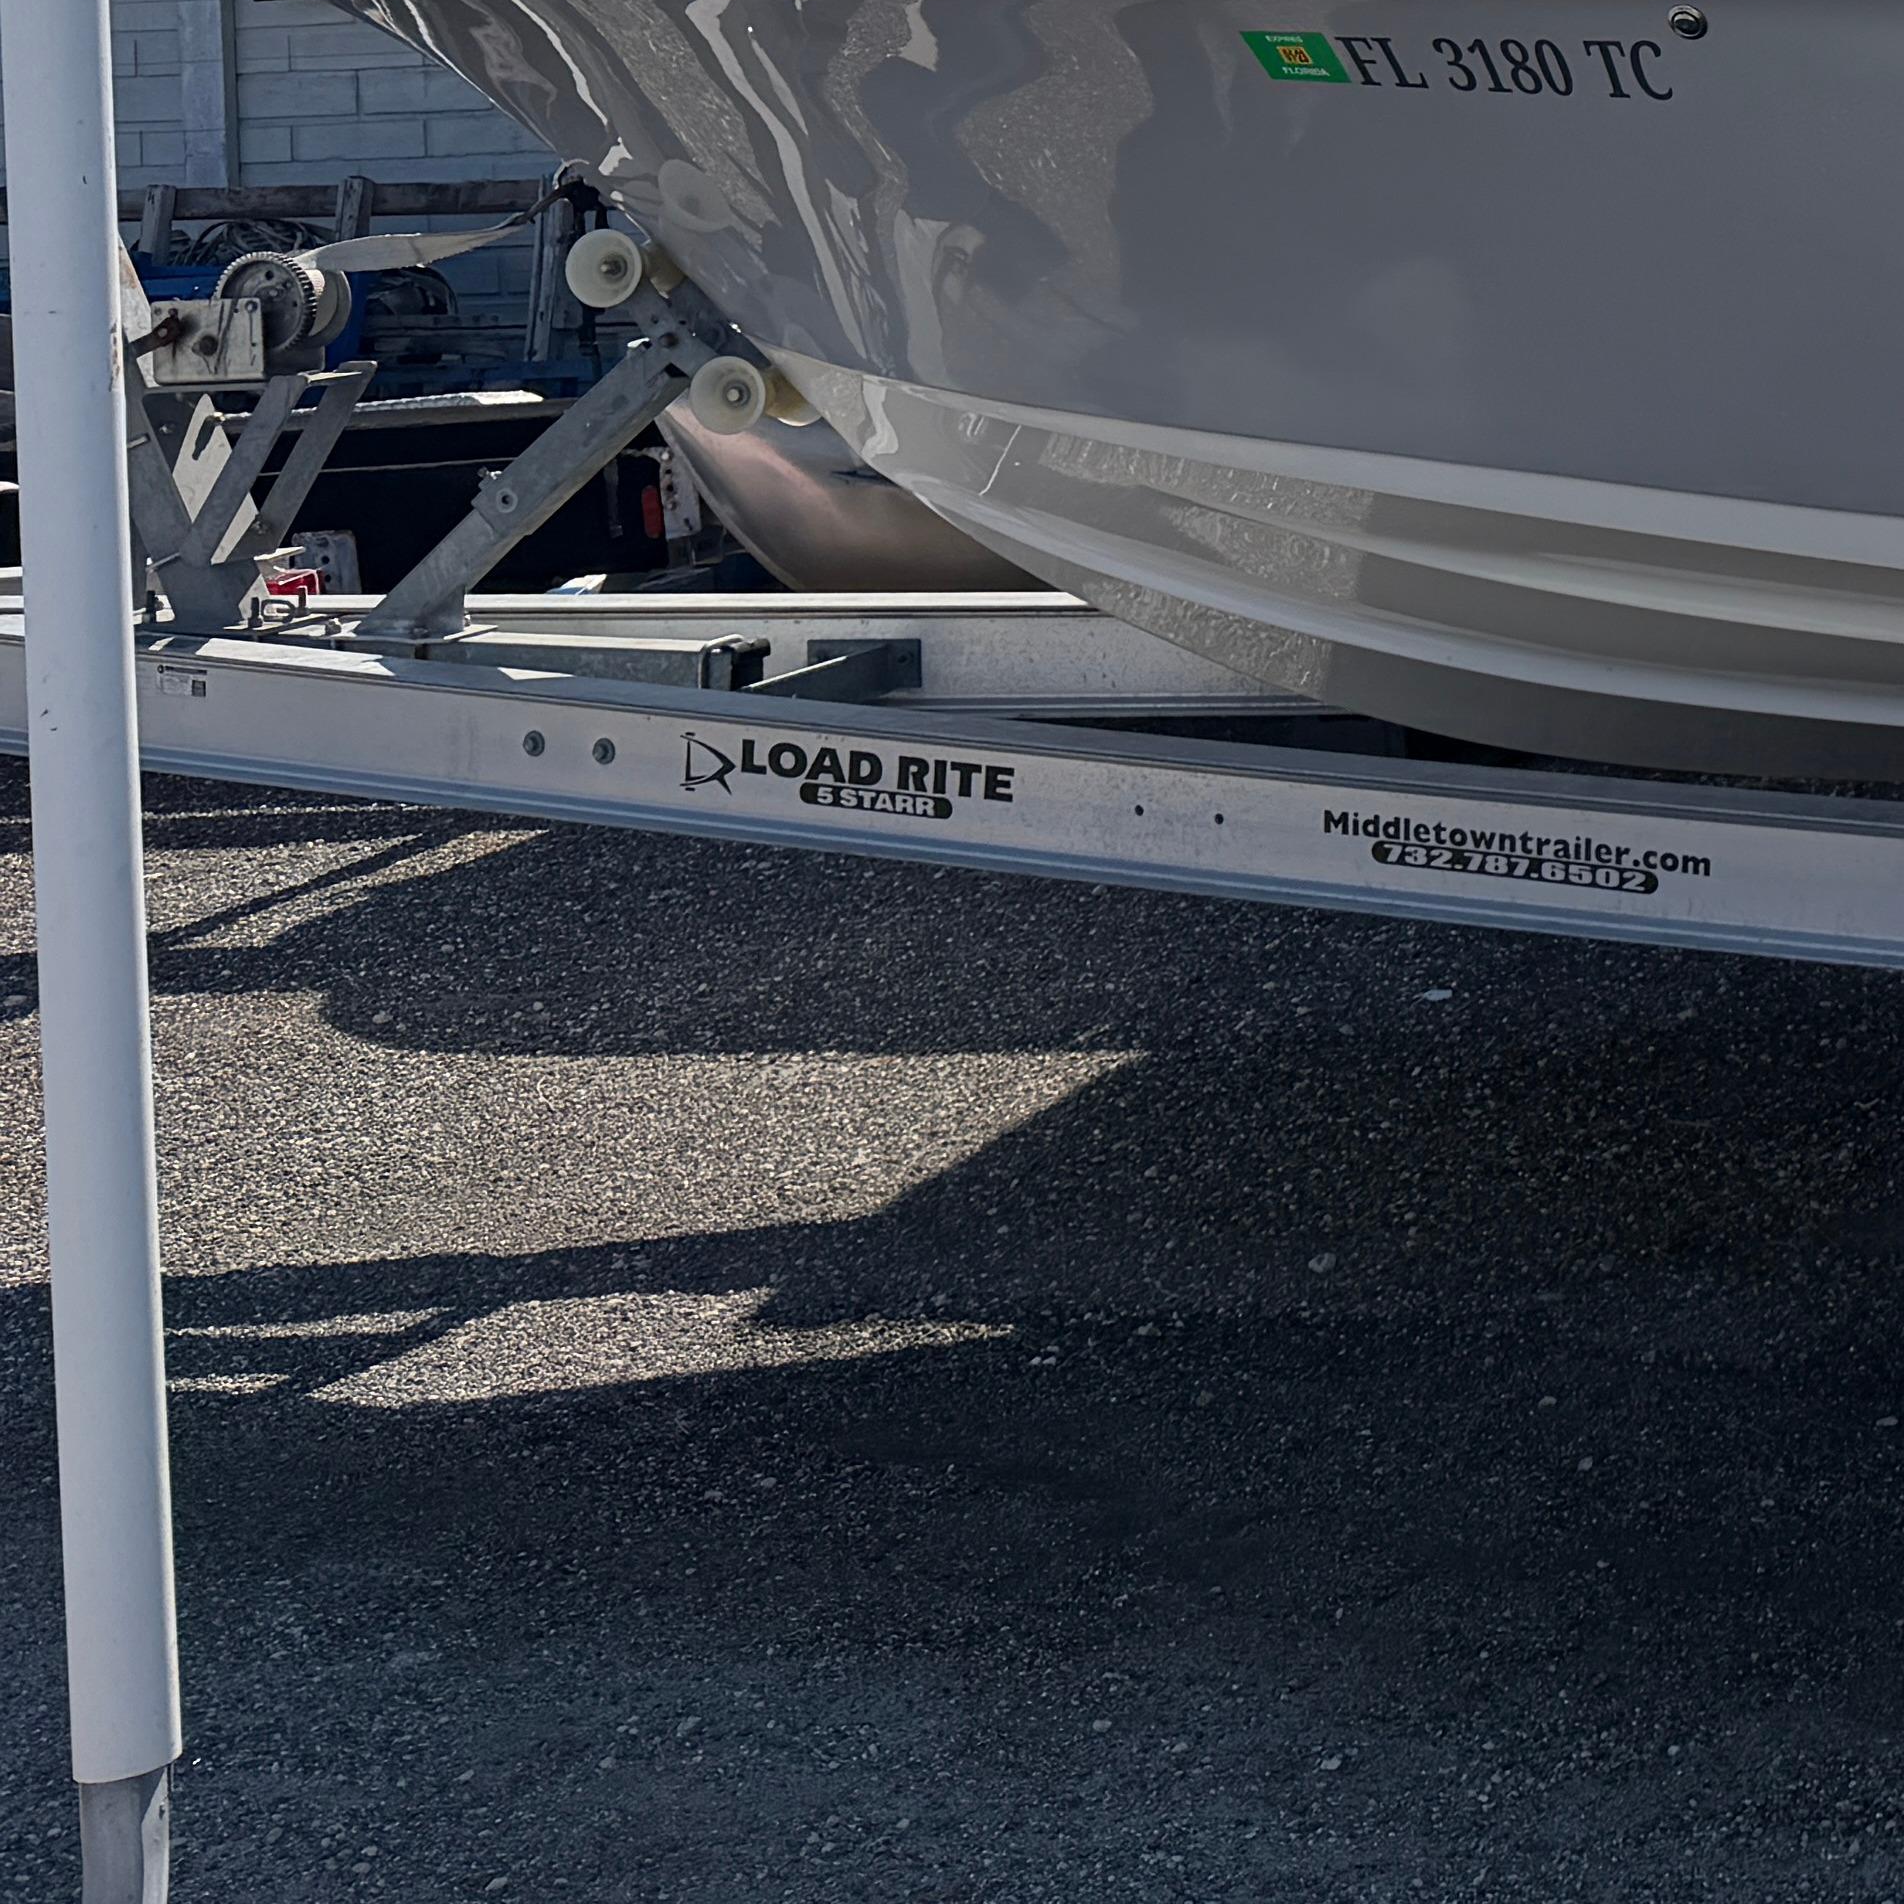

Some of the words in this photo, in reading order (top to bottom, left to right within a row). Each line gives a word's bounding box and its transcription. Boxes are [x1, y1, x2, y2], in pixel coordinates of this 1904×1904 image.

[1334, 36, 1429, 90] FL
[1432, 38, 1574, 97] 3180
[1583, 40, 1674, 102] TC
[740, 739, 883, 785] LOAD
[897, 755, 1016, 803] RITE
[816, 786, 835, 805] 5
[839, 788, 936, 816] STARR
[1323, 809, 1712, 877] Middletowntrailer.com
[1382, 843, 1648, 893] 732.787.6502
